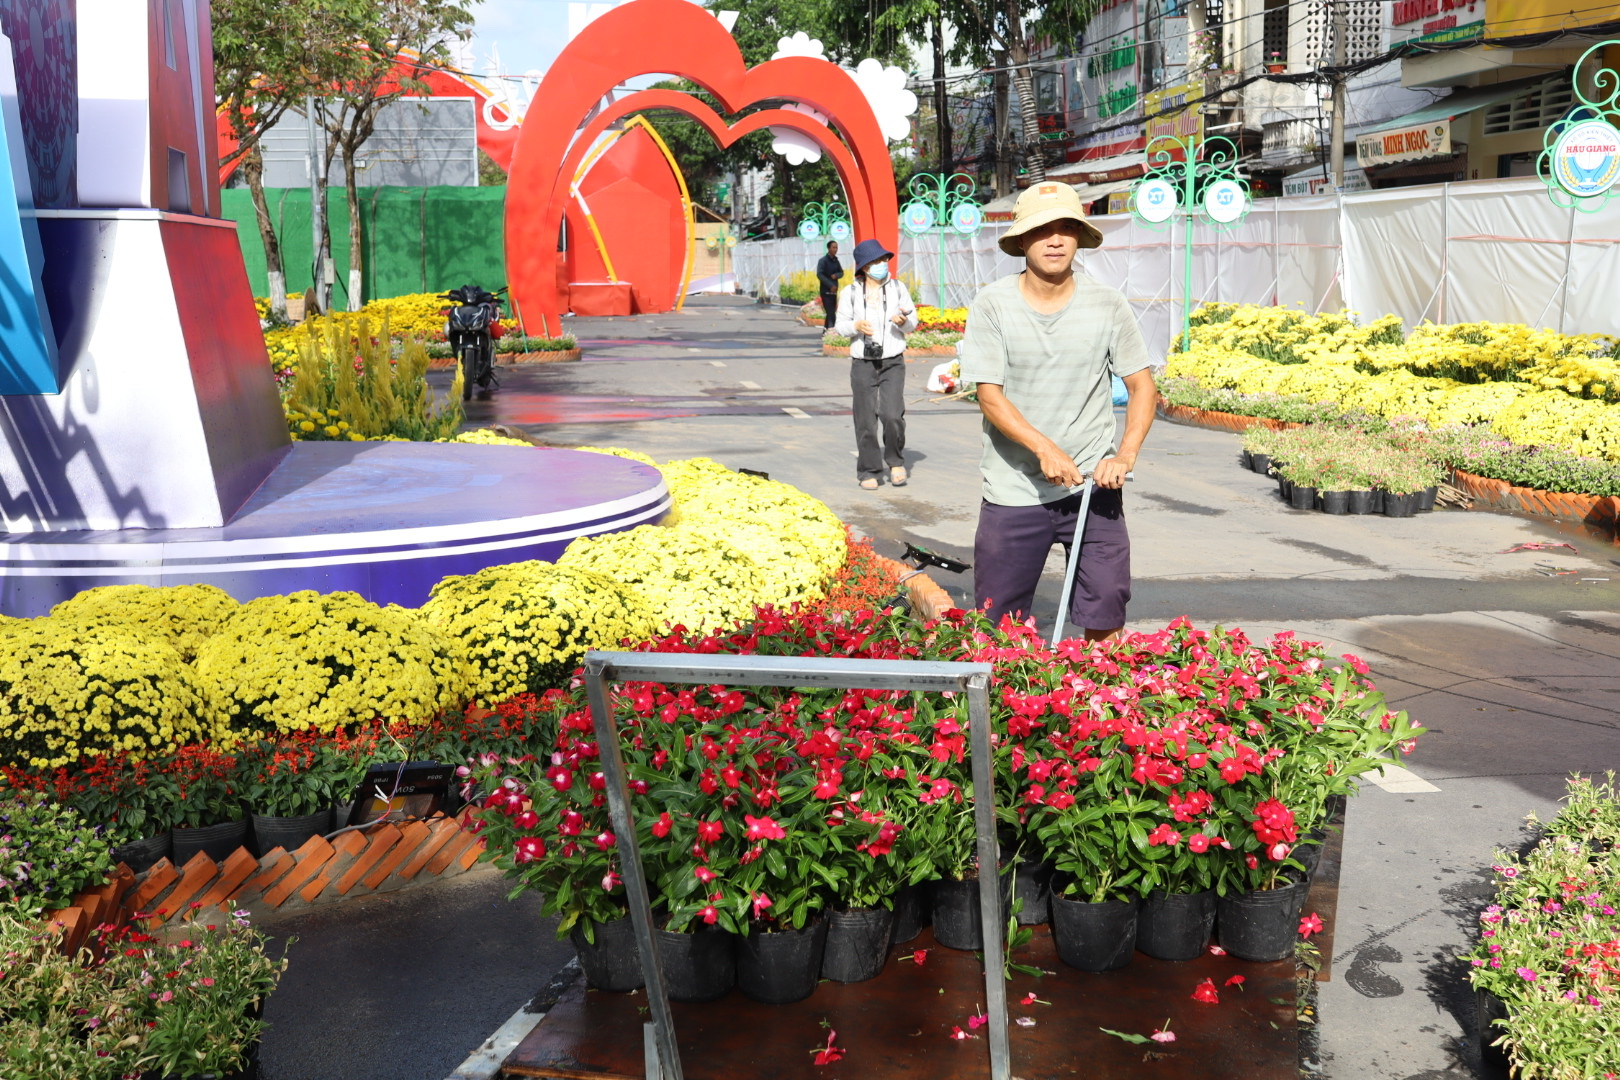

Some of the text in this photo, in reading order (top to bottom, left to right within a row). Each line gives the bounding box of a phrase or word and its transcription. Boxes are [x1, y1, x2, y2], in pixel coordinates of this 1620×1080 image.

[1383, 133, 1405, 156] MINH
[1404, 129, 1430, 154] NGỌC
[1586, 145, 1616, 153] GIANG
